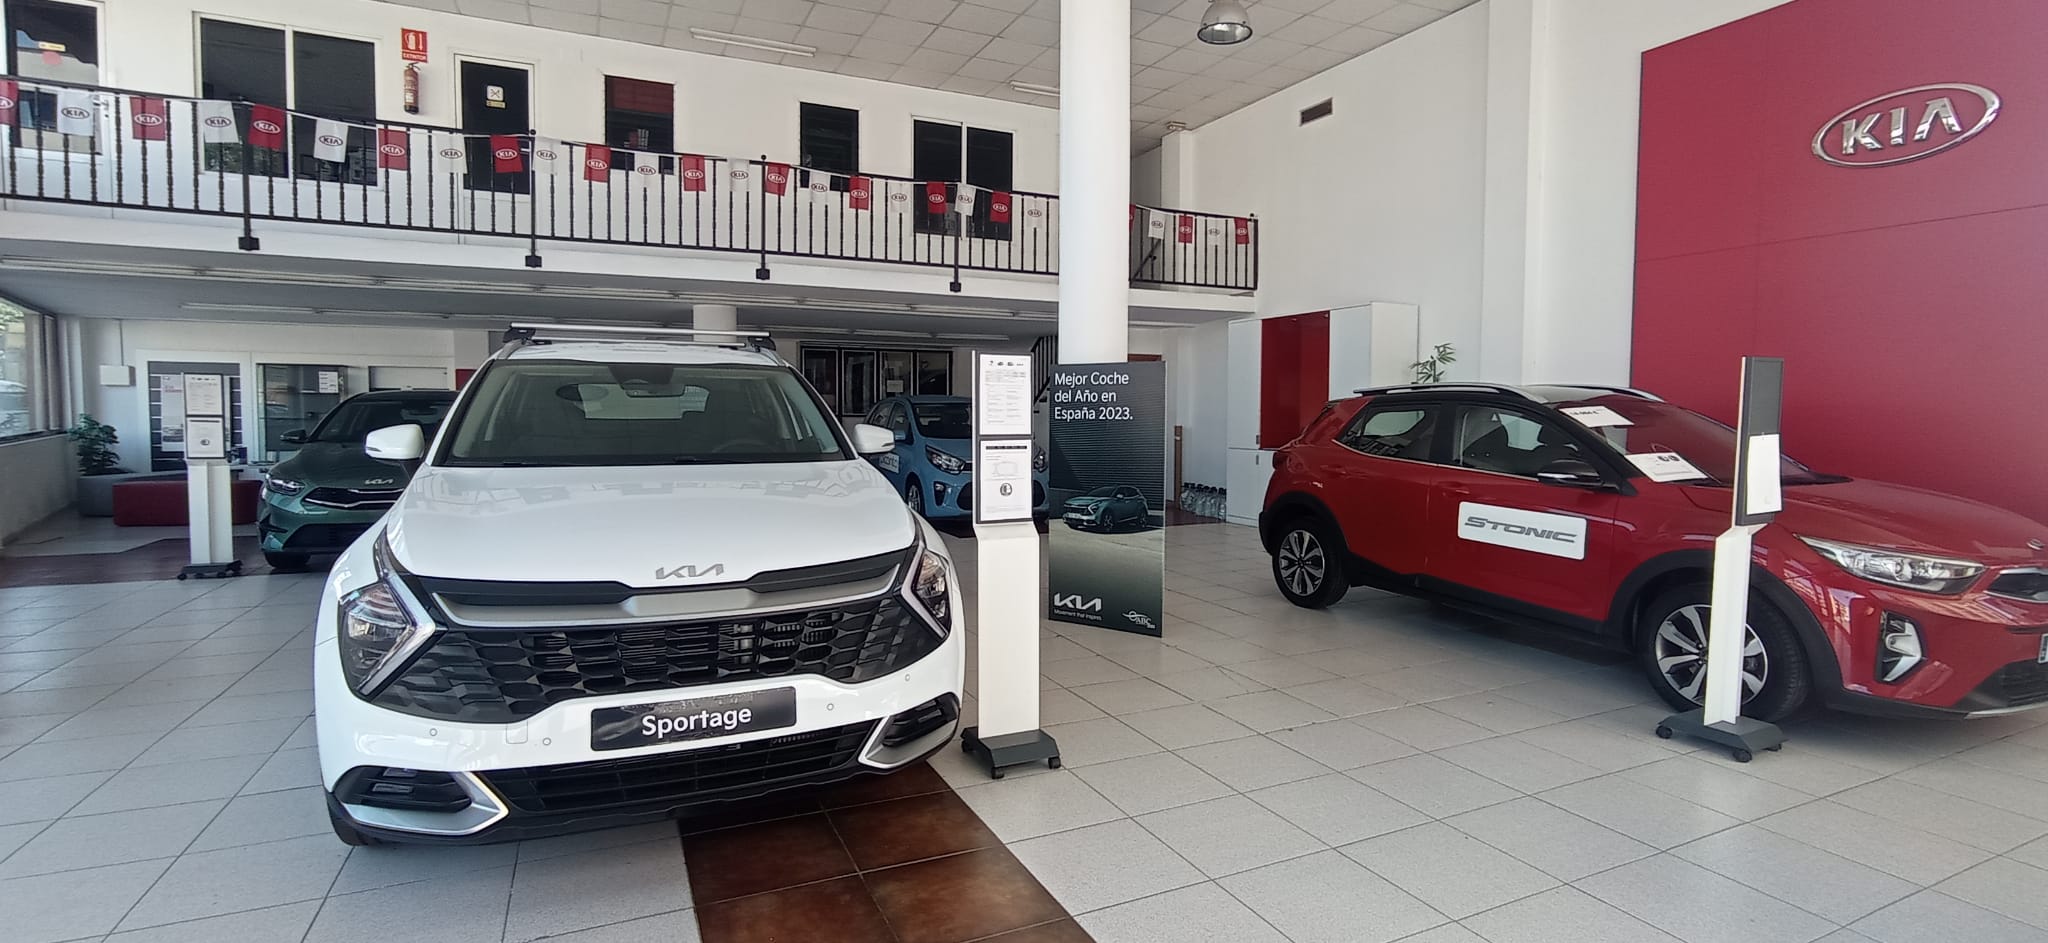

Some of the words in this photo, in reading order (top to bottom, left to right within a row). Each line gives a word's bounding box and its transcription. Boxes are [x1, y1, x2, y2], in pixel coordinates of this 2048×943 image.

[66, 109, 86, 117] KIA
[138, 115, 157, 123] KIA
[210, 117, 227, 125] KIA
[258, 122, 275, 131] KIA
[1842, 97, 1962, 154] KIA
[323, 136, 339, 145] KIA
[385, 145, 401, 154] KIA
[443, 150, 460, 158] KIA
[499, 150, 515, 158] KIA
[539, 151, 554, 159] KIA
[590, 160, 605, 169] KIA
[640, 166, 653, 174] KIA
[687, 170, 702, 178] KIA
[1054, 372, 1088, 388] Mejor
[1090, 371, 1129, 385] Coche
[1054, 389, 1071, 402] del
[1074, 389, 1098, 402] Año
[1101, 391, 1116, 402] en
[1054, 407, 1096, 422] España
[1098, 407, 1133, 420] 2023.
[1464, 516, 1578, 543] STONIC
[655, 563, 725, 580] KIA
[1053, 592, 1102, 612] KIA
[641, 706, 752, 739] Sportage
